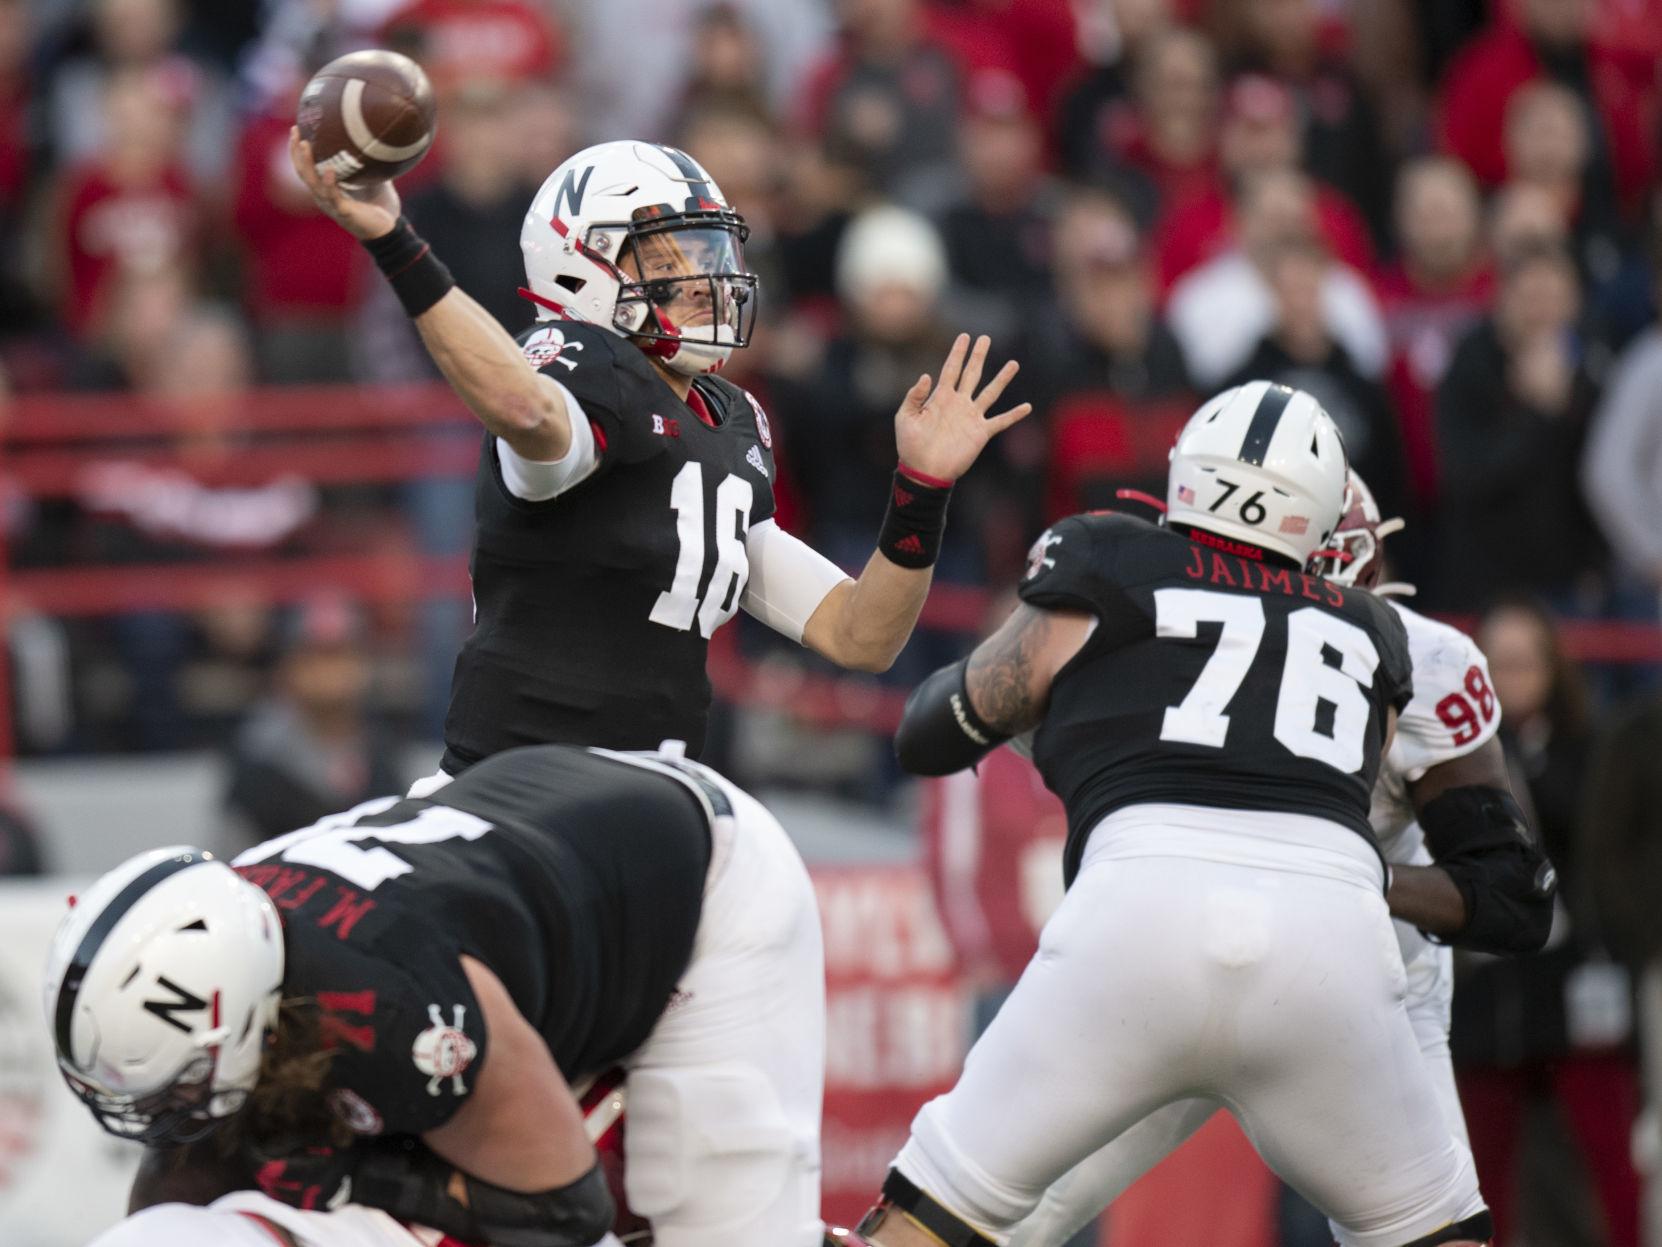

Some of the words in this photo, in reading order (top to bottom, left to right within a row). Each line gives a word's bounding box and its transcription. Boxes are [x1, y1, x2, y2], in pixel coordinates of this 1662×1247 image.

[1208, 478, 1267, 526] 76
[648, 460, 754, 641] 16
[1186, 546, 1344, 609] JAIMES
[1153, 587, 1381, 775] 76
[1435, 665, 1494, 748] 98
